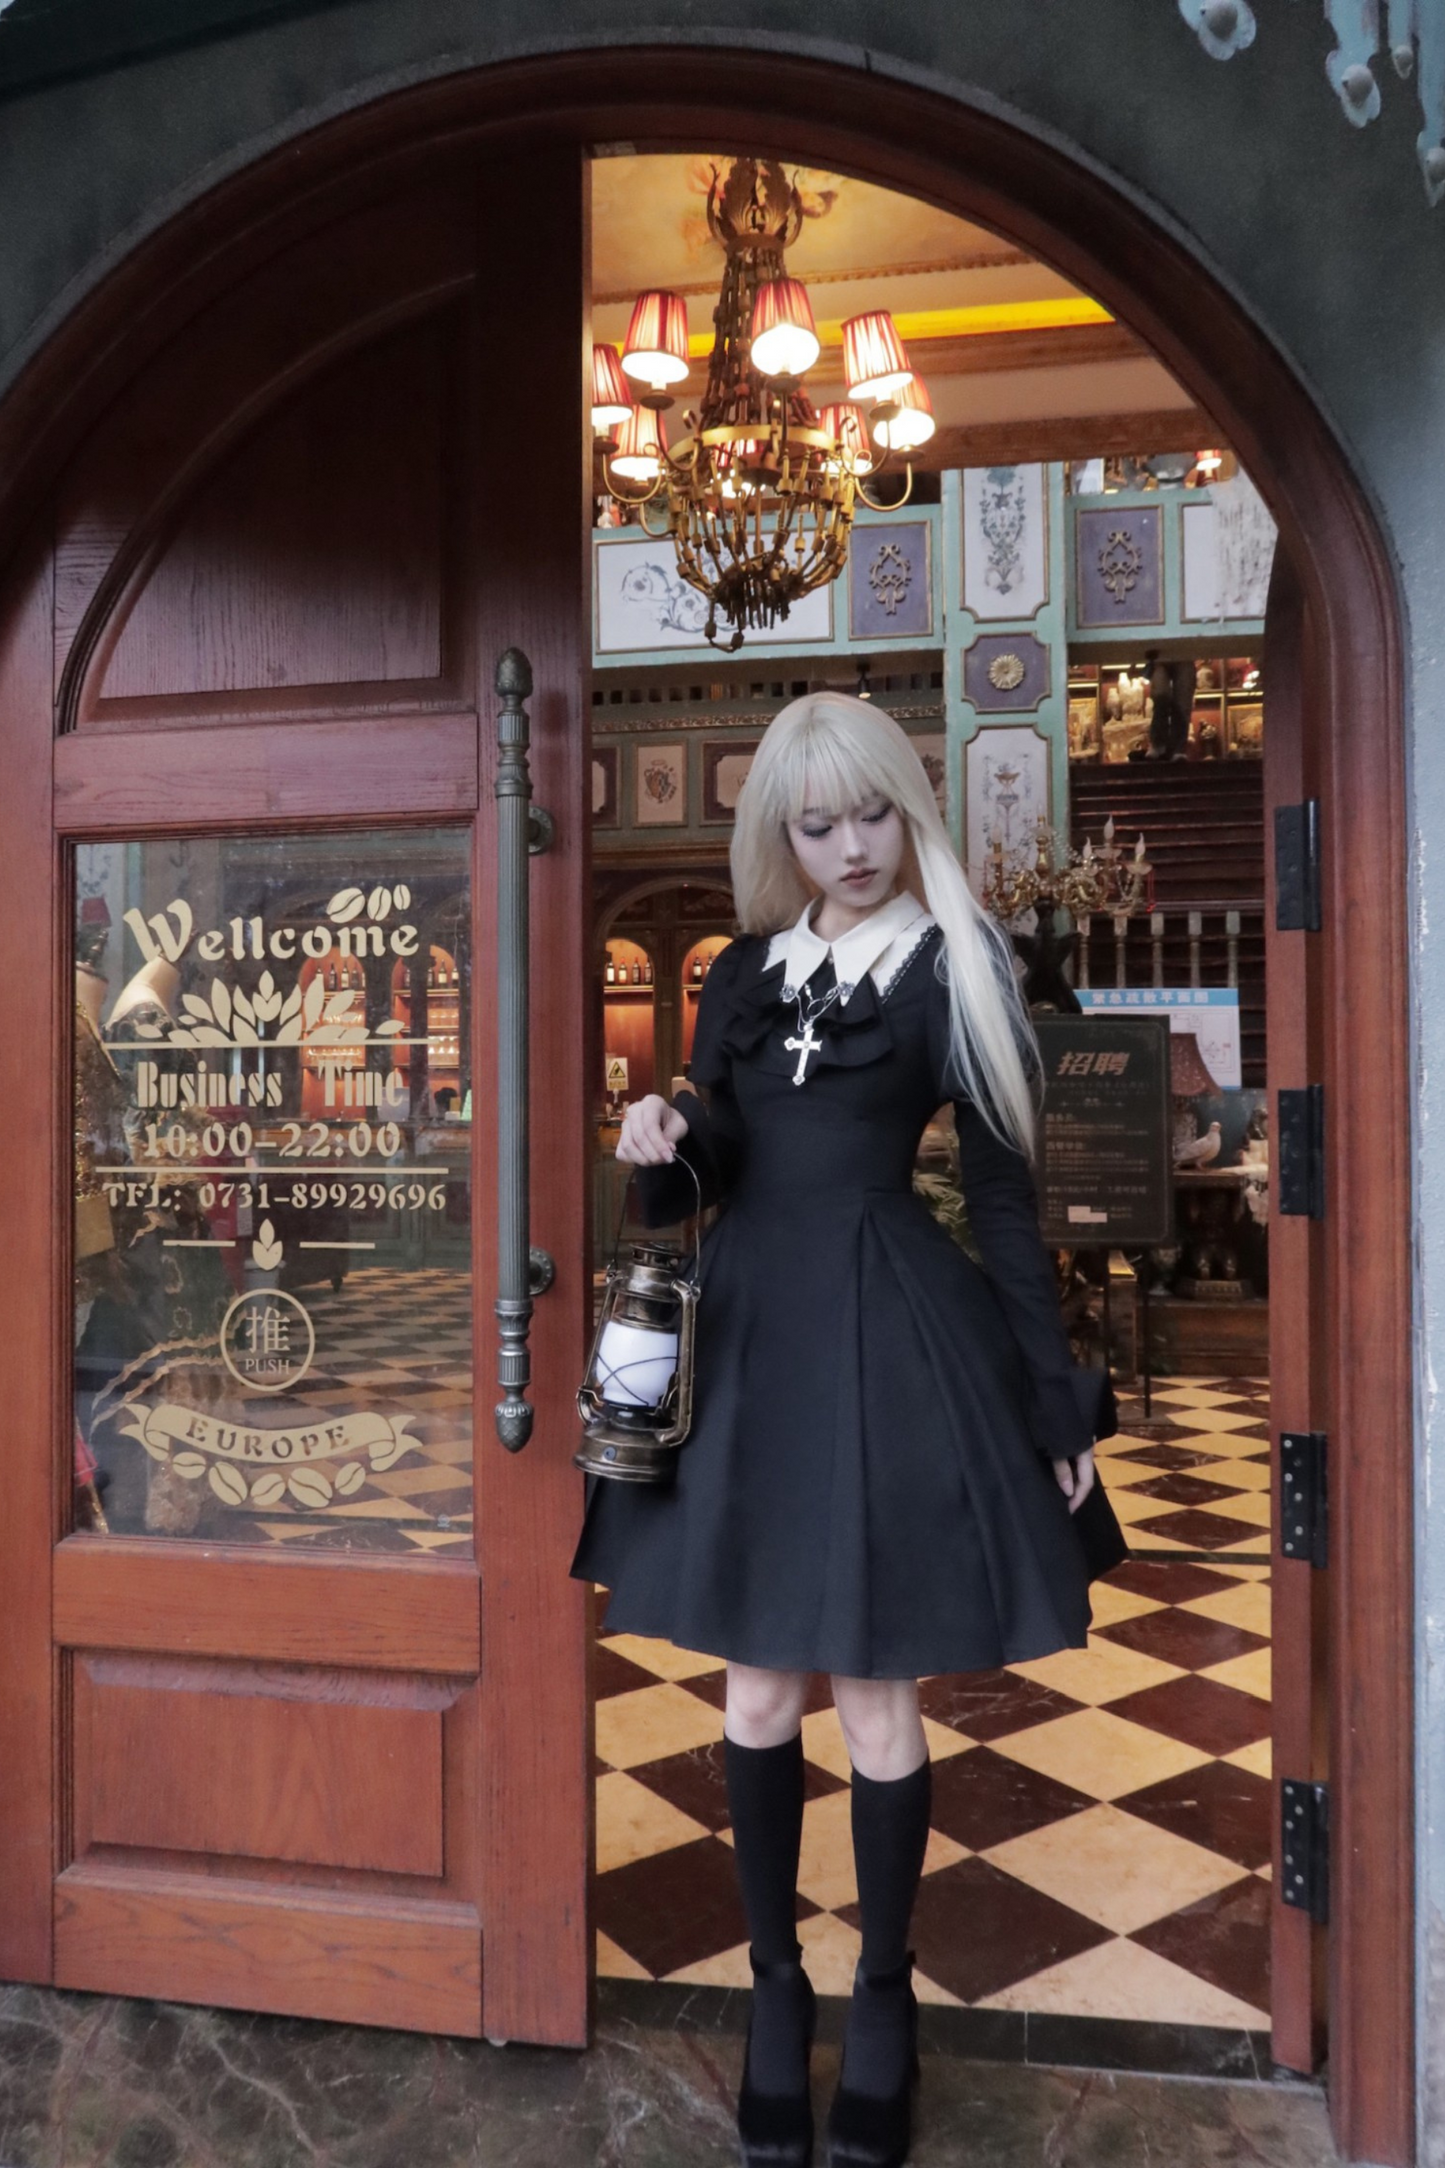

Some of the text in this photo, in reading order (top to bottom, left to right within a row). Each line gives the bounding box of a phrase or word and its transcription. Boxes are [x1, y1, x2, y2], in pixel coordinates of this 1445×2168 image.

[123, 898, 420, 963] Wellcome
[1057, 1052, 1130, 1076] 招聘
[136, 1059, 404, 1108] Business Time
[143, 1122, 401, 1158] 10:00-22:00
[200, 1183, 446, 1211] 0731-89929696
[246, 1306, 290, 1354] 推
[245, 1358, 290, 1375] PUSH
[187, 1417, 350, 1458] EUROPE
